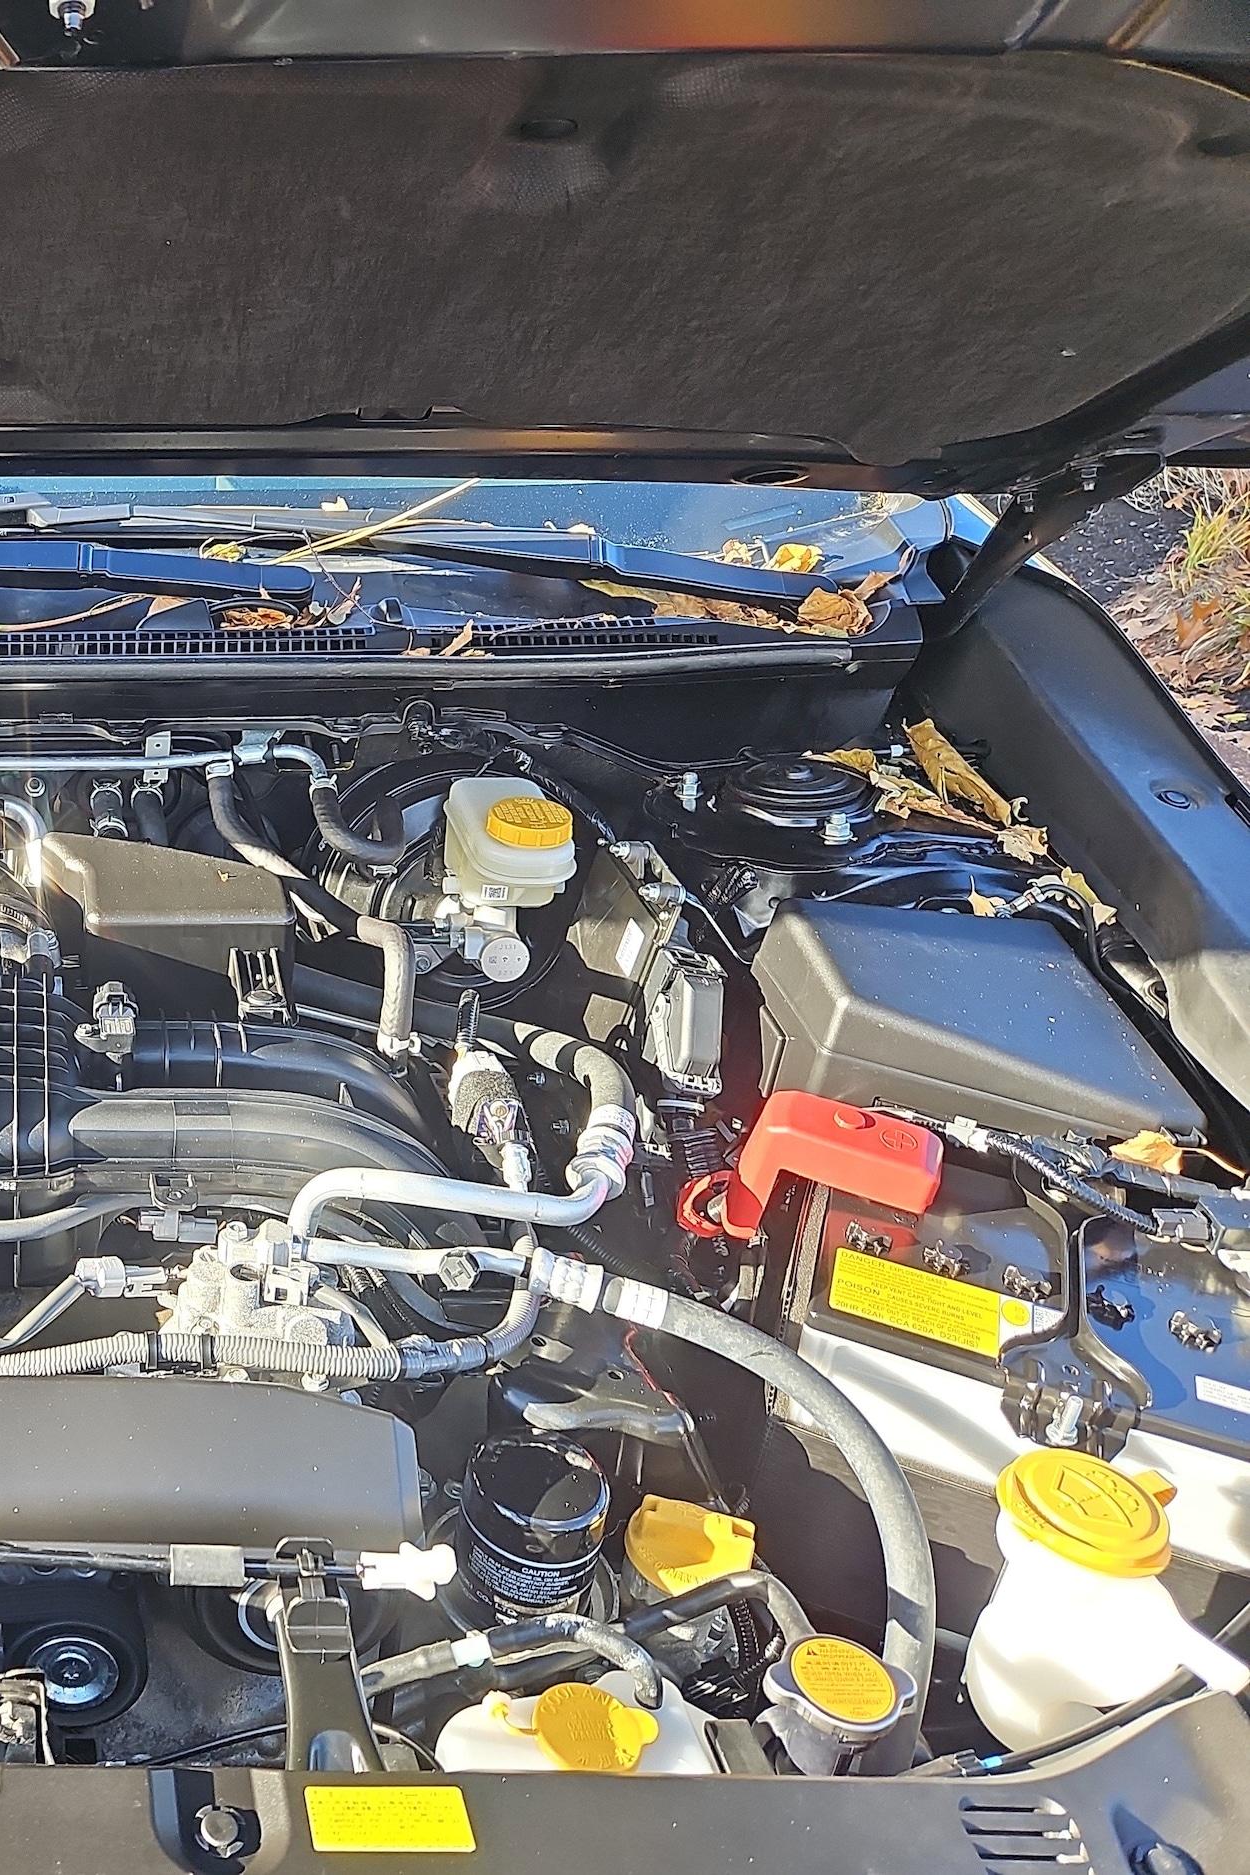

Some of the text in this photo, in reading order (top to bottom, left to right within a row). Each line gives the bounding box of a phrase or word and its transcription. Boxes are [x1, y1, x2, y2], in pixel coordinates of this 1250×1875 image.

[841, 1251, 885, 1269] DANGER
[890, 1265, 924, 1279] EXPLOSIVE
[926, 1276, 948, 1286] GASES
[837, 1278, 880, 1296] POISON
[871, 1282, 983, 1319] KEEP VENT CAPS TIGHT AND LEVEL
[835, 1299, 859, 1311] 20HR
[861, 1307, 884, 1319] 62Ah
[890, 1316, 910, 1327] CCA
[912, 1323, 934, 1335] 620A
[868, 1303, 885, 1312] KEEP
[912, 1316, 935, 1327] REACH
[947, 1326, 980, 1341] CHILDREN
[887, 1294, 965, 1321] CAUSES SEVERE BURNS
[521, 1567, 560, 1578] CAUTION
[539, 1685, 620, 1714] COOLANT
